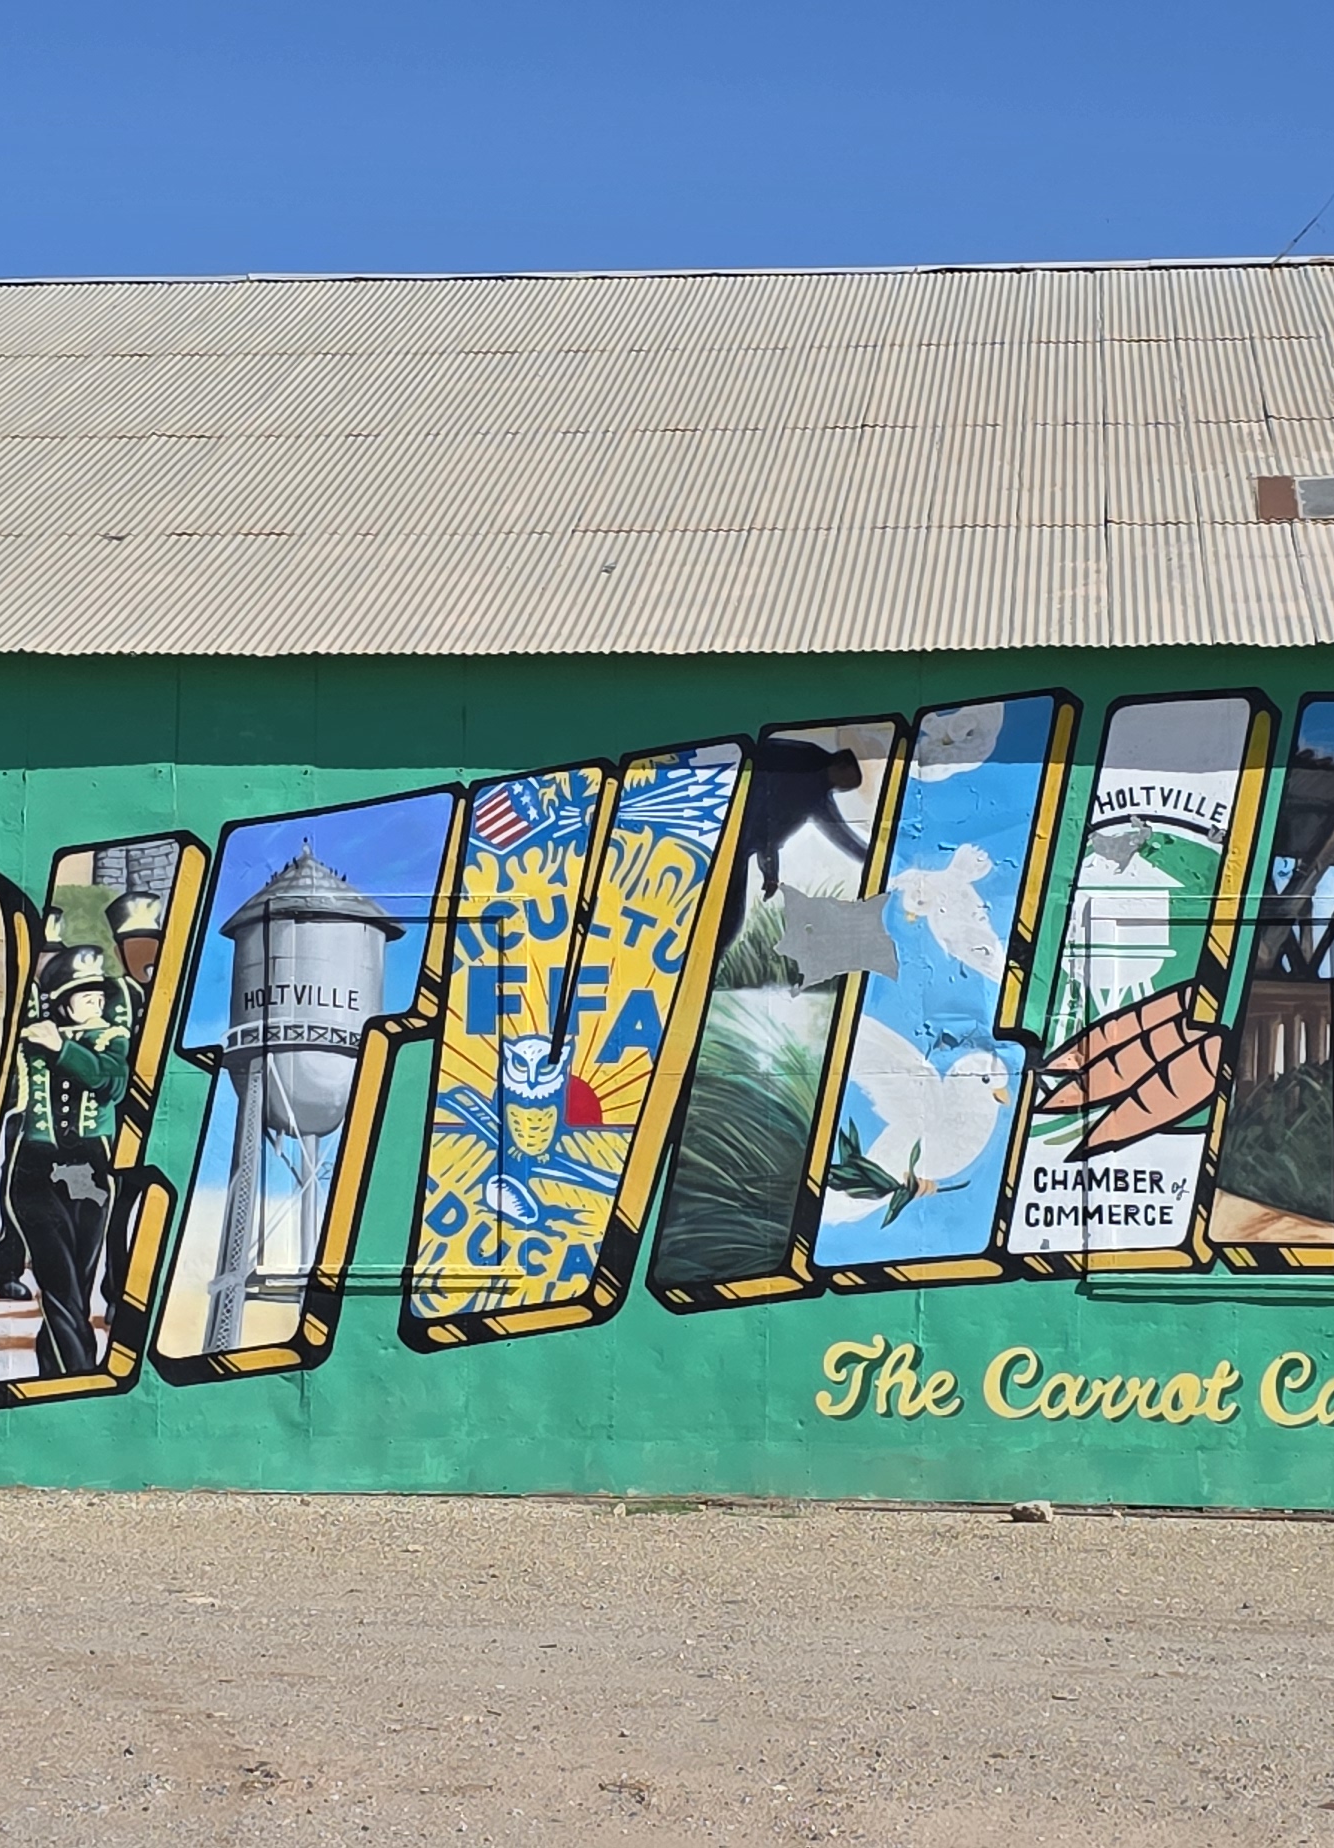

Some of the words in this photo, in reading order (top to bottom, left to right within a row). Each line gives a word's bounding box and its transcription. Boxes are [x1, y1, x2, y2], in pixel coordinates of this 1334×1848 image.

[1096, 785, 1228, 824] HOLTVILLE
[244, 983, 360, 1012] HOLTVILLE
[465, 965, 664, 1064] FFA
[1033, 1166, 1165, 1195] CHAMBER
[1171, 1178, 1191, 1201] of
[425, 1174, 603, 1283] DUCA
[1024, 1202, 1174, 1228] COMMERCE
[815, 1334, 964, 1420] The
[982, 1346, 1243, 1424] Carrot
